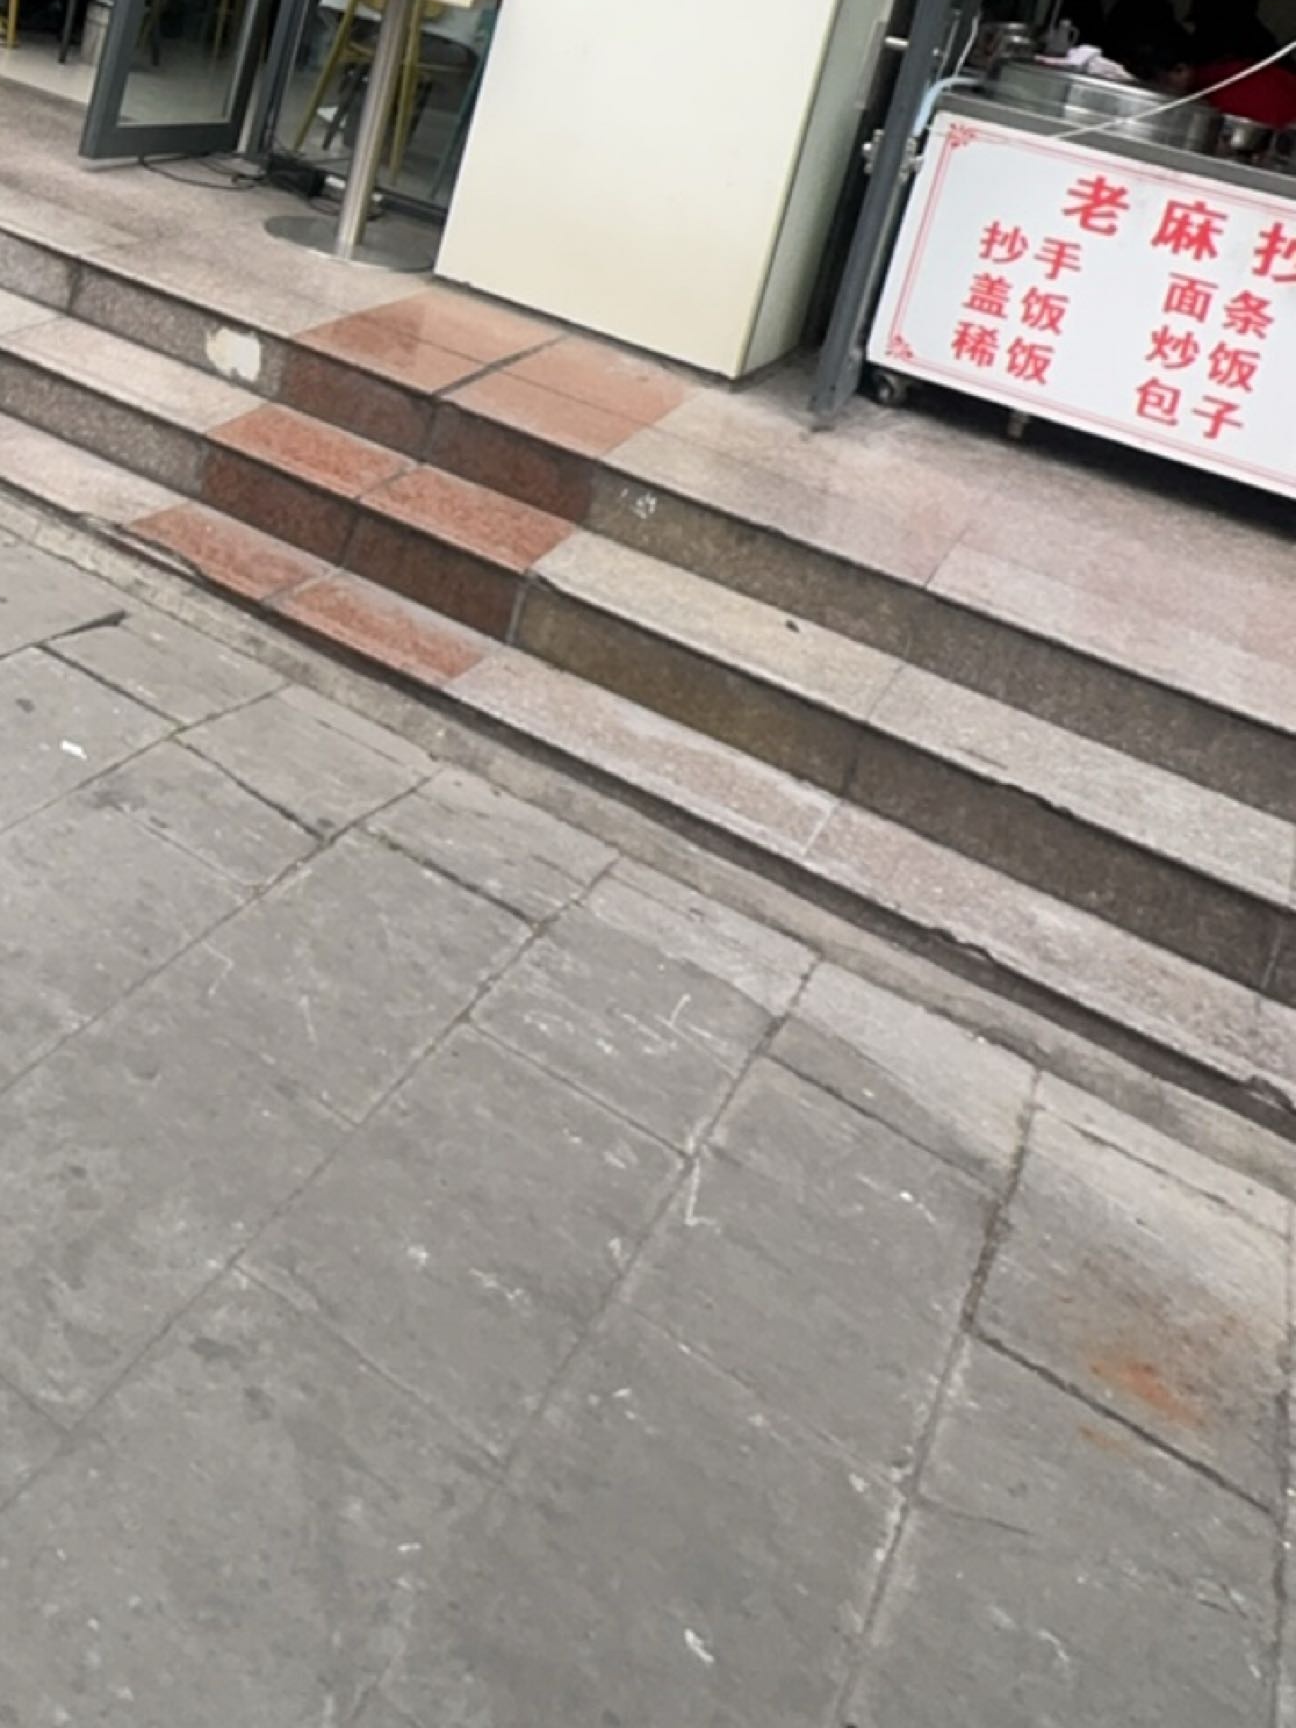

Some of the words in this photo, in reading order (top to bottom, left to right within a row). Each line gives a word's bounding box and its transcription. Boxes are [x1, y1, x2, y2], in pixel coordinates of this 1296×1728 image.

[979, 221, 1082, 280] 抄手
[962, 272, 1070, 336] 盖饭
[1162, 272, 1274, 339] 面条
[950, 321, 1055, 385] 稀饭
[1145, 324, 1261, 392] 炒饭
[1135, 376, 1244, 440] 包子
